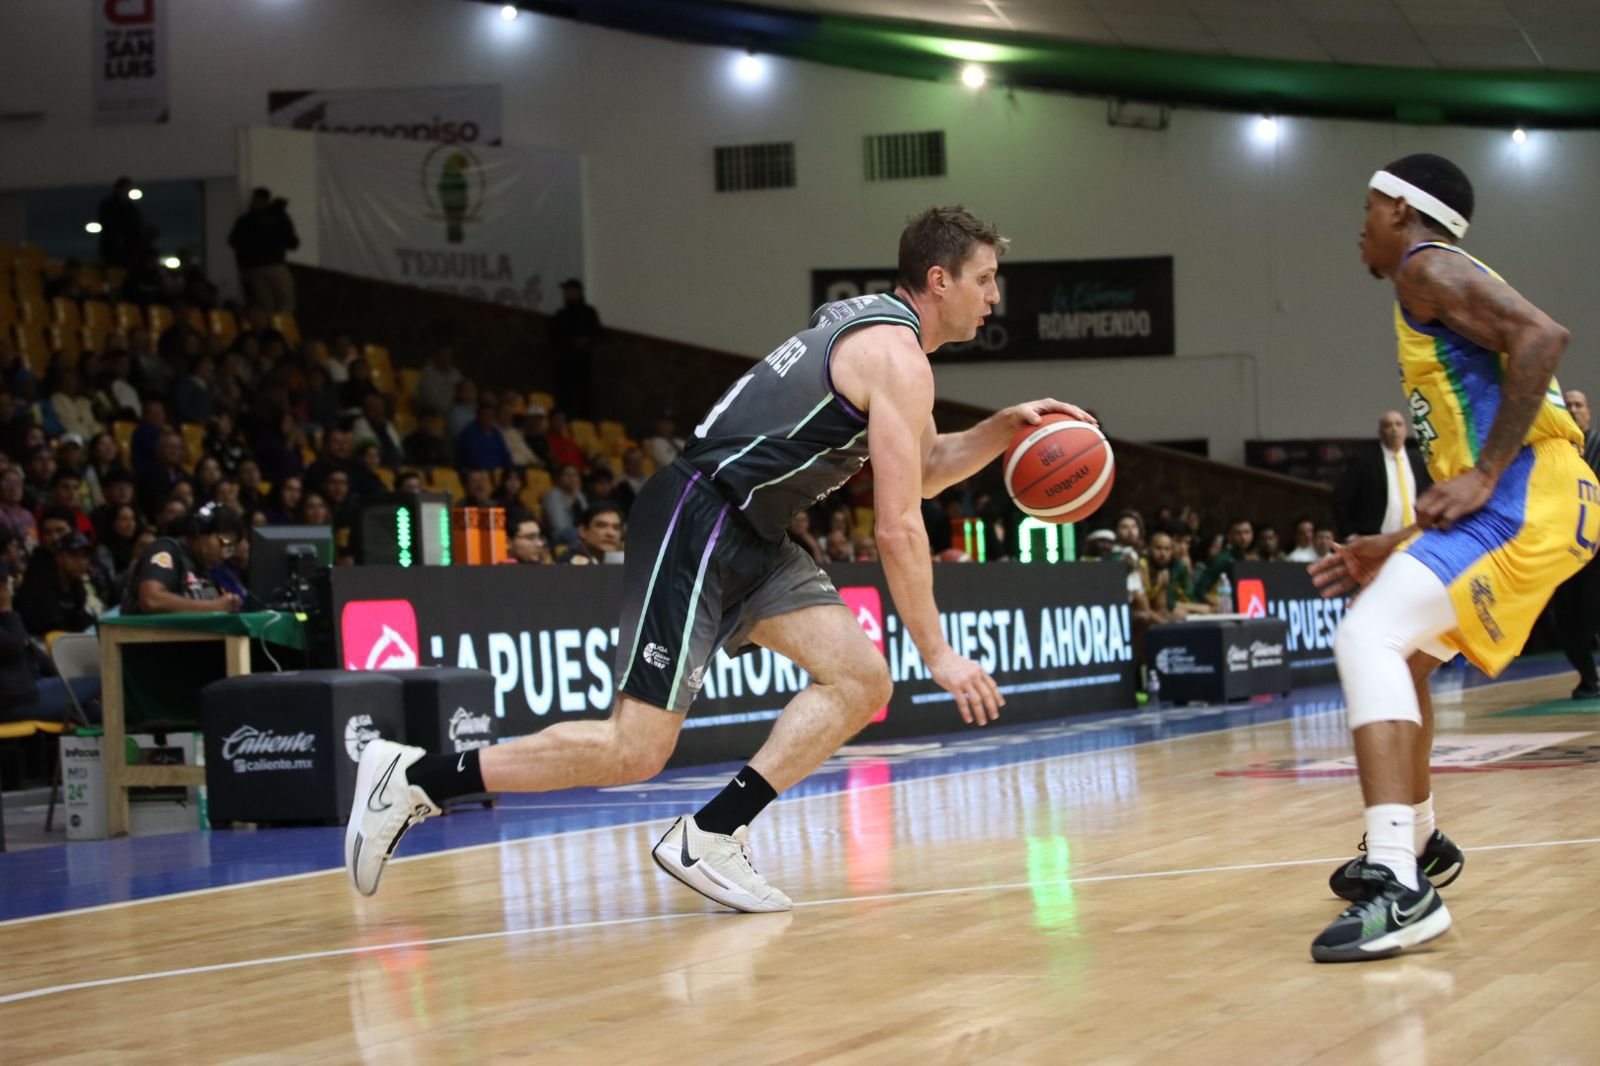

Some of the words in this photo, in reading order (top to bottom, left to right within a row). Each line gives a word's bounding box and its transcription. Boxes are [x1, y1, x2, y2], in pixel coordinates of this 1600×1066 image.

[105, 39, 154, 58] SAN
[104, 60, 155, 79] LUIS
[394, 248, 513, 281] TEQUILA
[1038, 309, 1152, 341] ROMPIENDO
[1044, 465, 1090, 498] molten
[1039, 603, 1133, 669] AHORA!
[246, 759, 314, 771] caliente.mx
